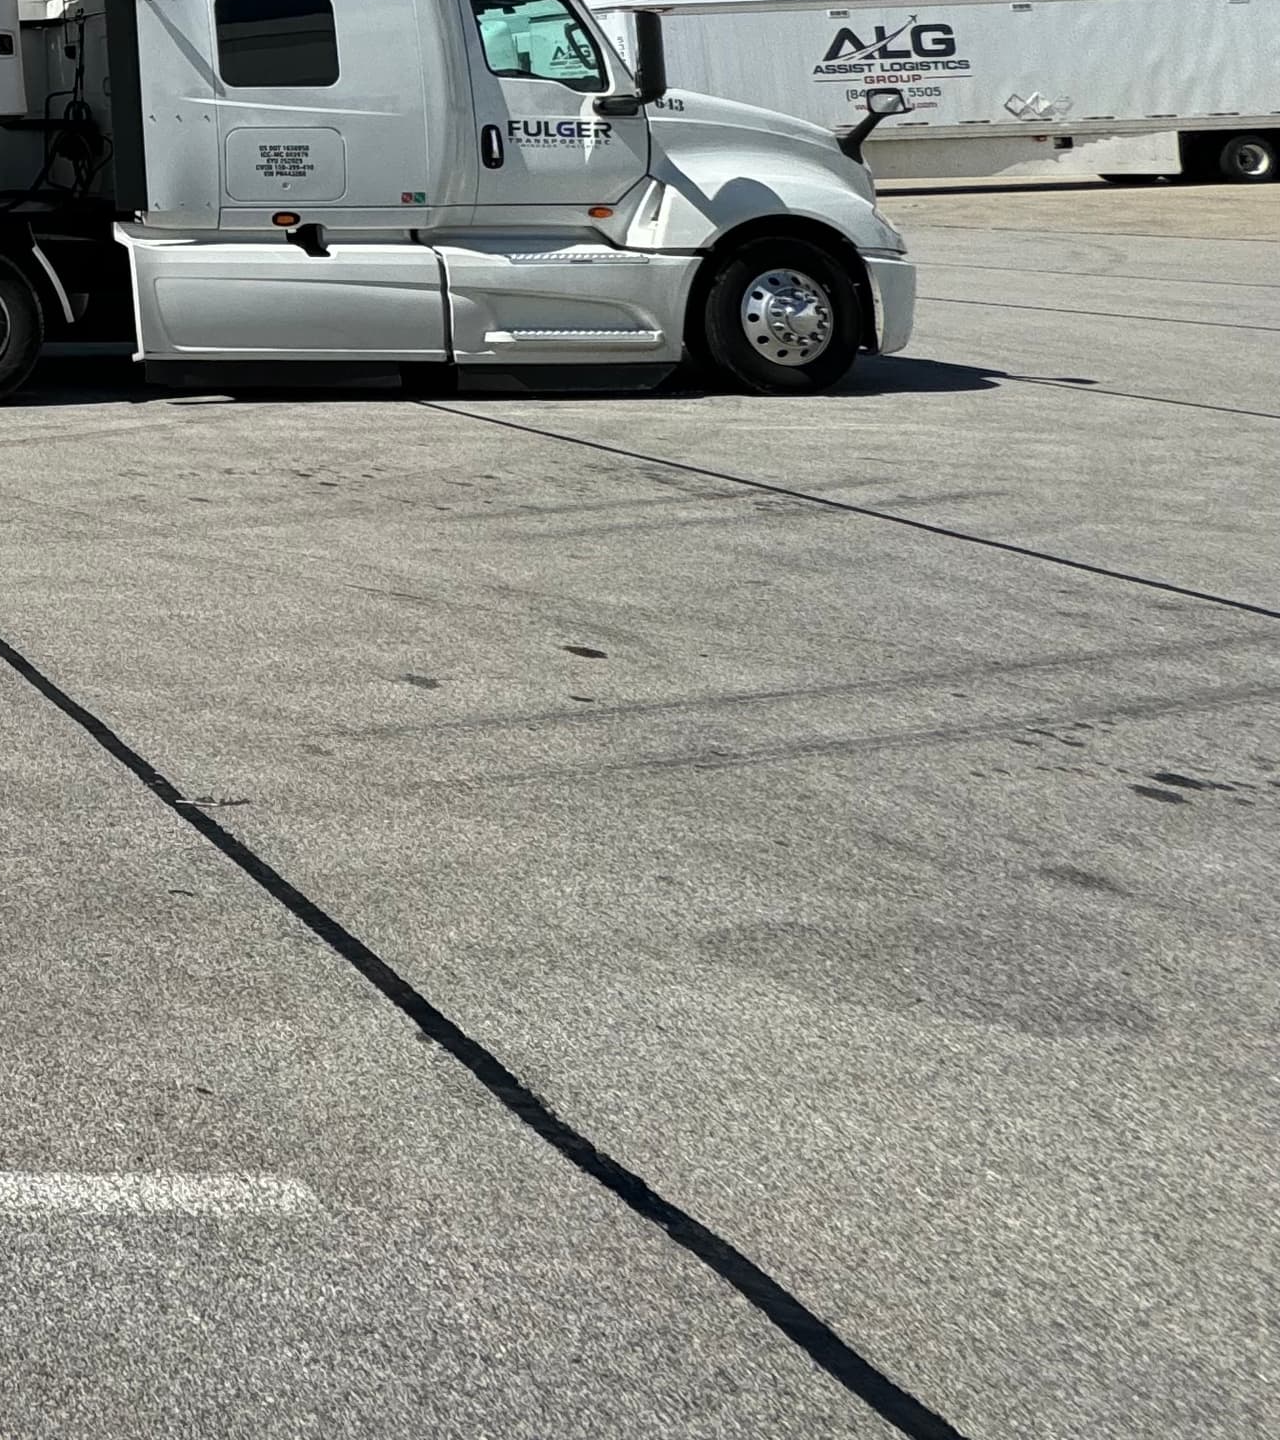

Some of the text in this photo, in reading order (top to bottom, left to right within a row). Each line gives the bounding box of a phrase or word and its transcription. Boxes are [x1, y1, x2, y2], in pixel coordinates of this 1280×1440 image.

[823, 23, 956, 61] ALG
[813, 59, 970, 74] ASSIST LOGISTICS
[864, 74, 922, 84] GROUP
[908, 86, 941, 97] 5505
[507, 120, 612, 138] FULGER
